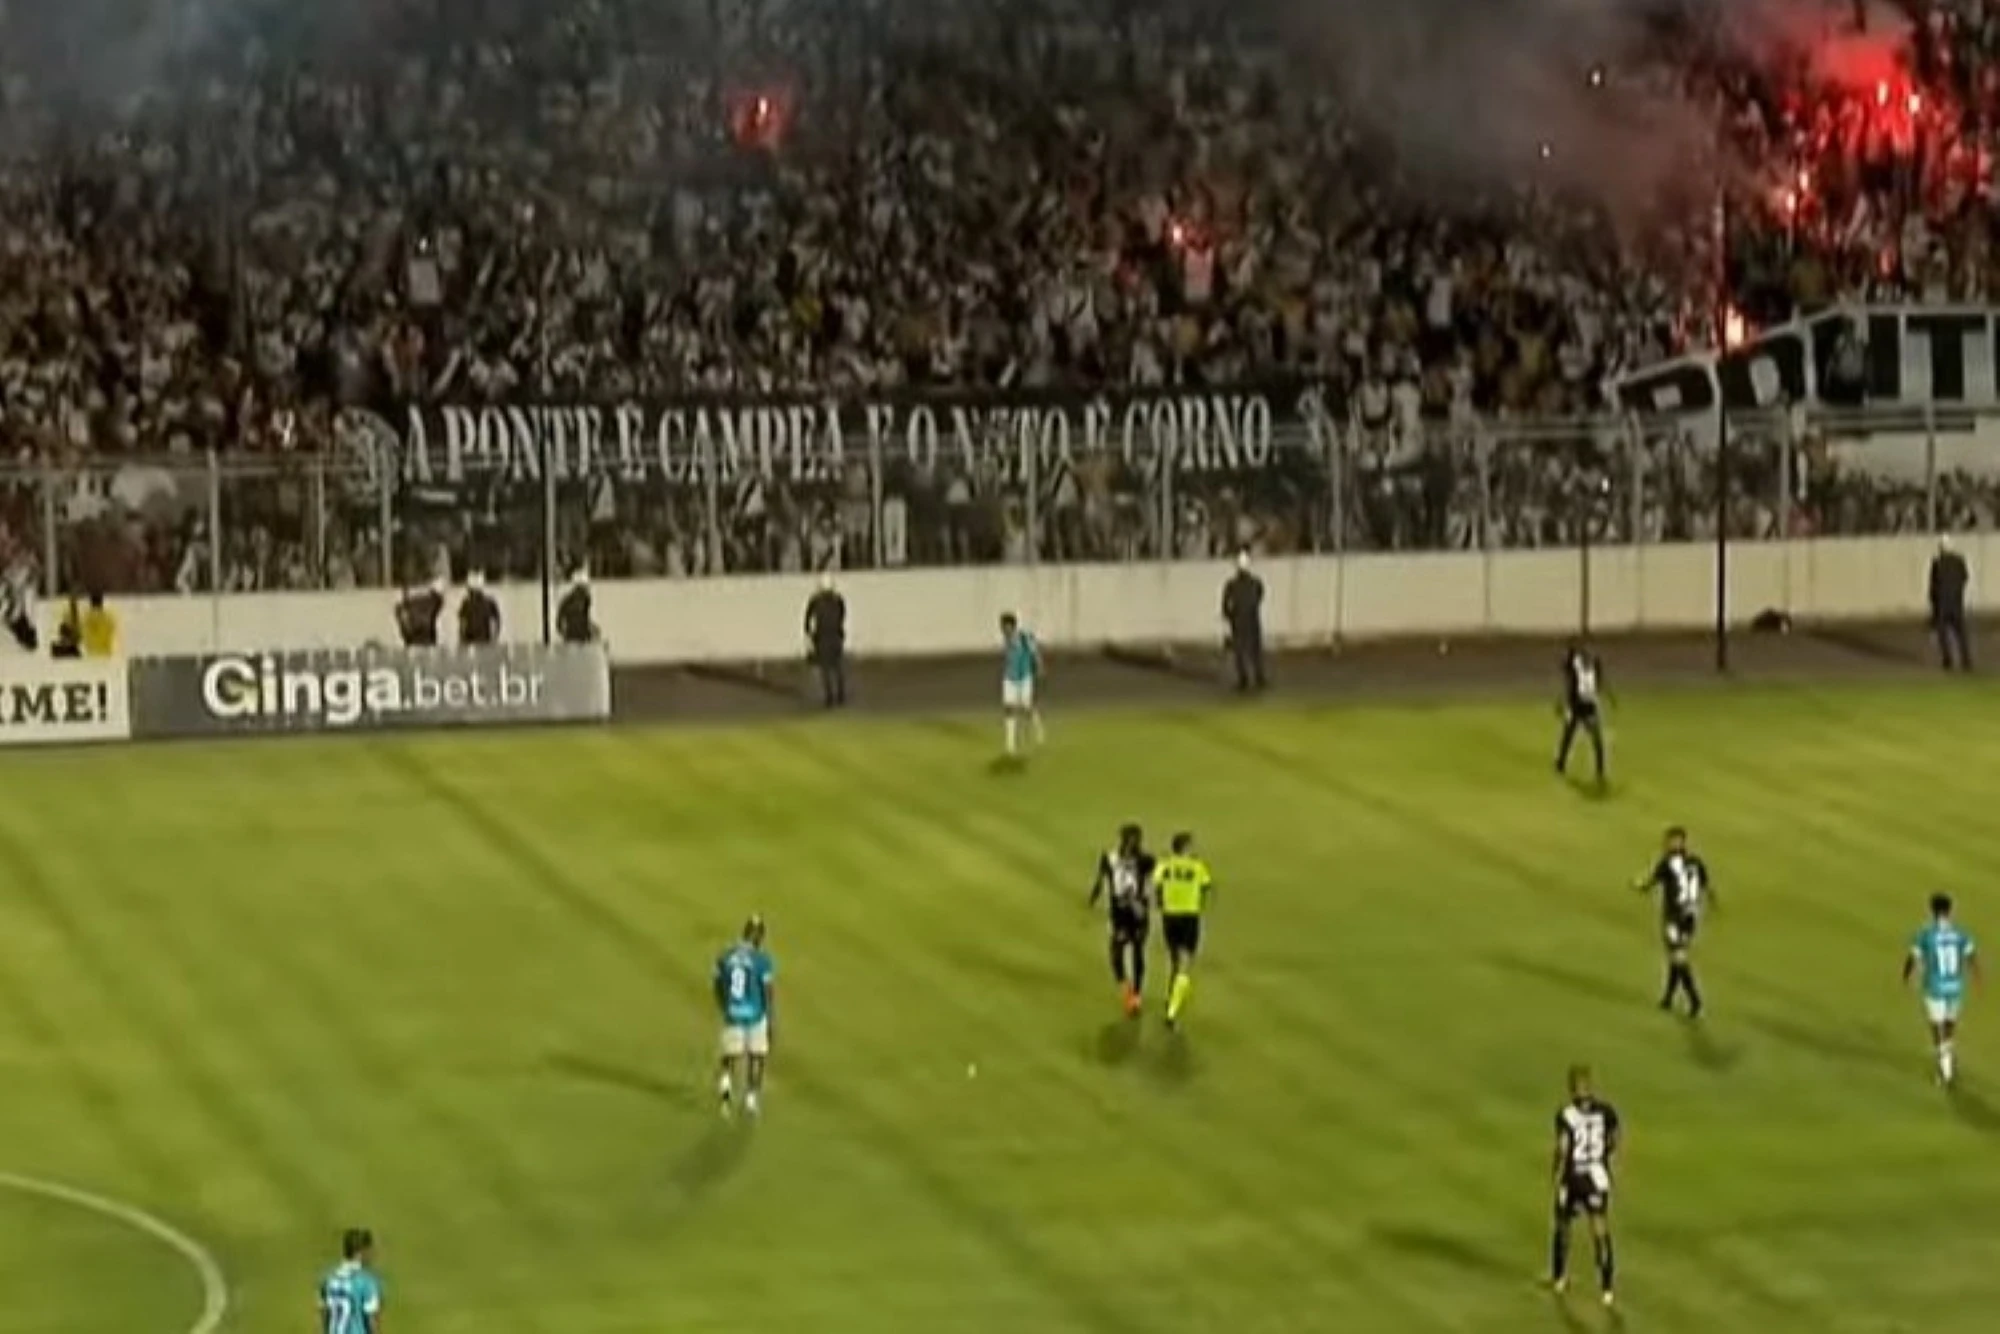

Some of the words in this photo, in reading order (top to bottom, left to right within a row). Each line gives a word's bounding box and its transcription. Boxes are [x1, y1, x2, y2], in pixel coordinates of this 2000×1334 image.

[403, 404, 431, 483] A
[441, 404, 604, 483] PONTE
[906, 403, 939, 470] O
[0, 681, 107, 724] ME!
[202, 656, 545, 725] Ginga.bet.br
